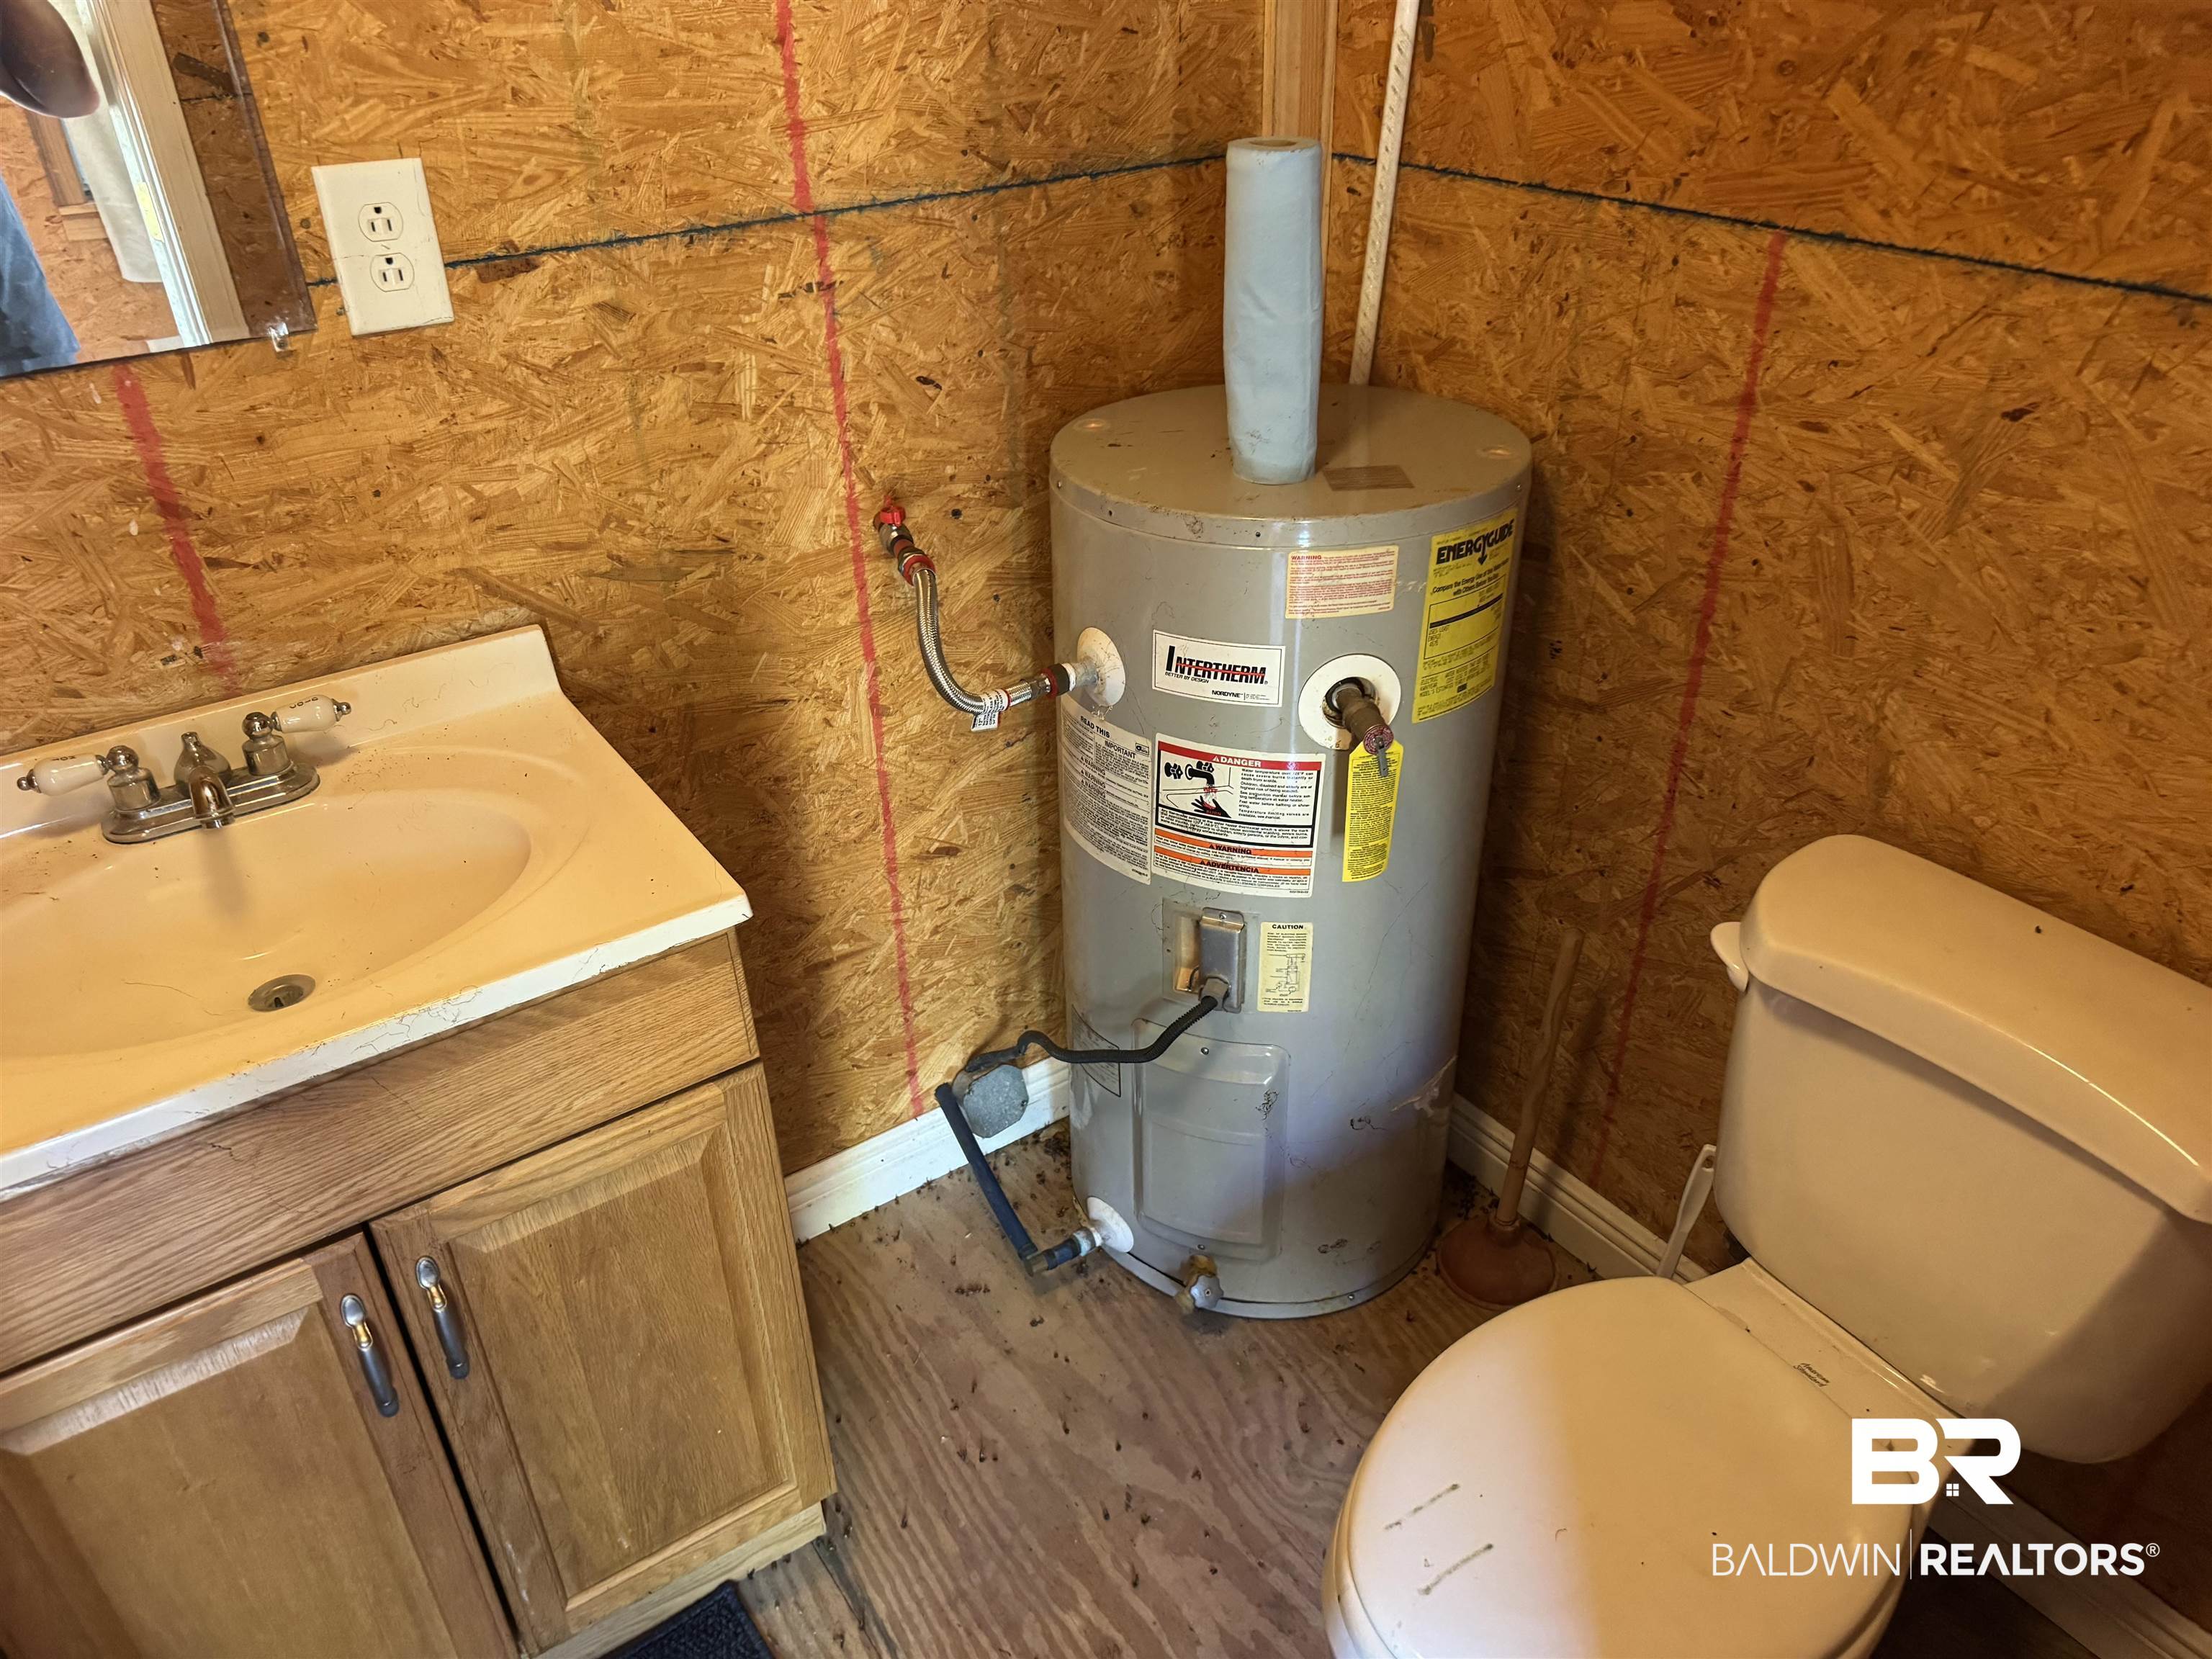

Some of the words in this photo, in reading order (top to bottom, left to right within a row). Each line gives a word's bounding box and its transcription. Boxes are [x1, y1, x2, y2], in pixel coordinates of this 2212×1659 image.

[1437, 518, 1514, 565] ENERGYGUIDE
[1080, 716, 1094, 729] READ
[1096, 725, 1110, 738] THIS
[1105, 740, 1136, 759] IMPORTANT
[1085, 758, 1105, 775] WARNING
[1220, 756, 1262, 768] DANGER
[1085, 772, 1105, 788] WARNING
[1215, 844, 1252, 855] WARNING
[1210, 861, 1259, 874] ADVERTENCIA
